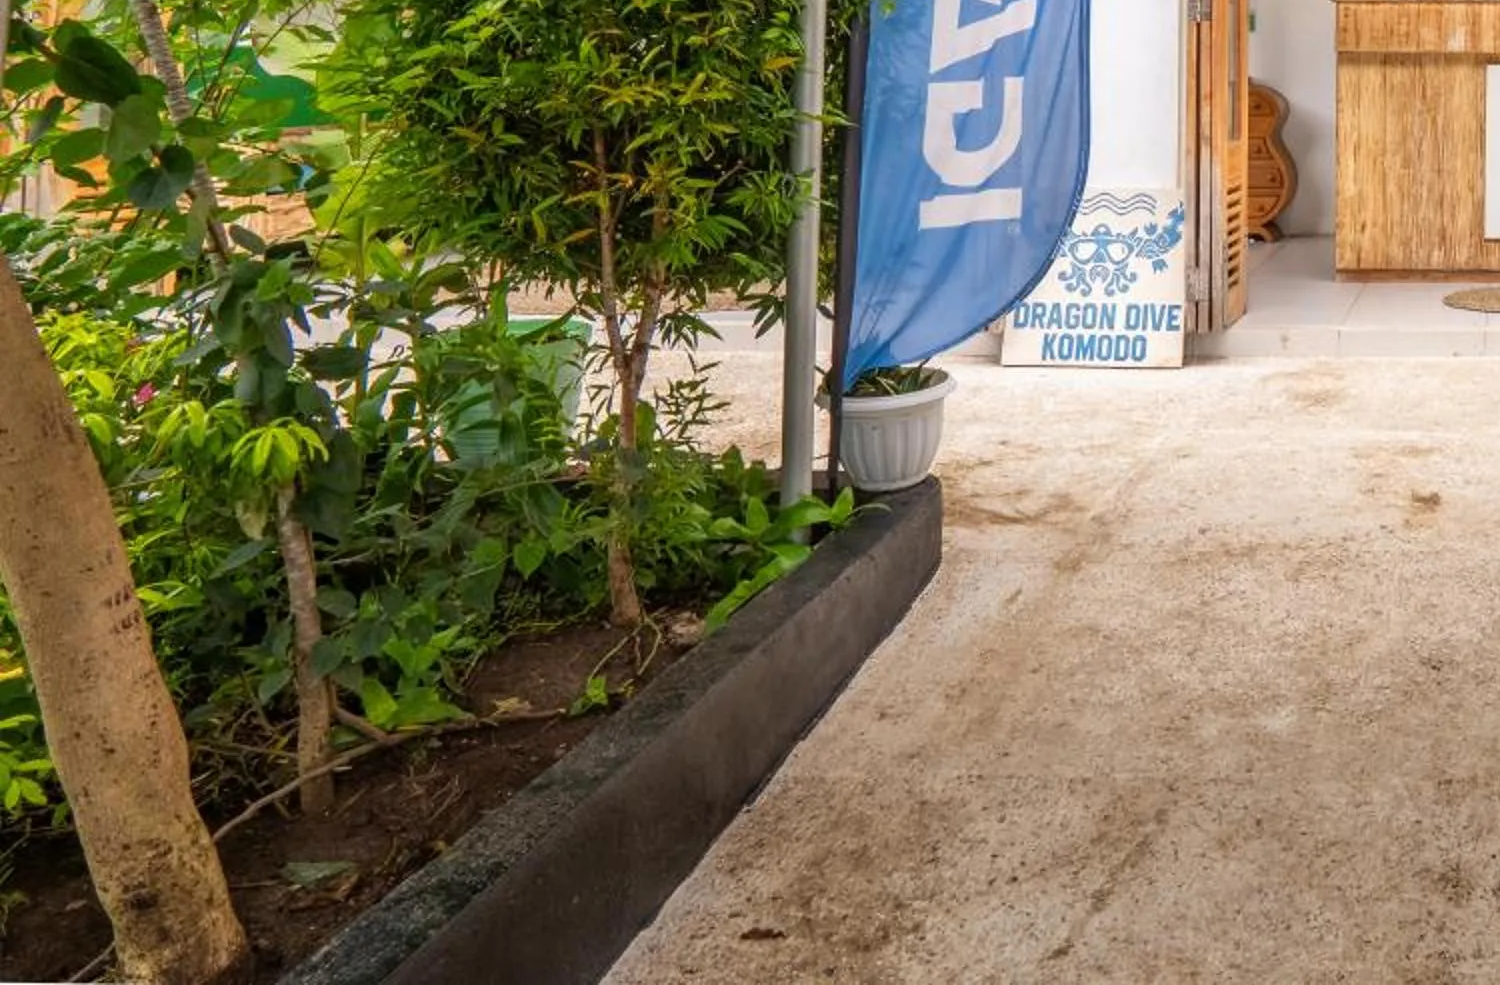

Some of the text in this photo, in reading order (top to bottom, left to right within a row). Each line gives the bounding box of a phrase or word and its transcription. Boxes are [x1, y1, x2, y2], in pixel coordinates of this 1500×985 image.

[1013, 302, 1182, 332] DRAGON DIVE
[1041, 333, 1147, 361] KOMODO
